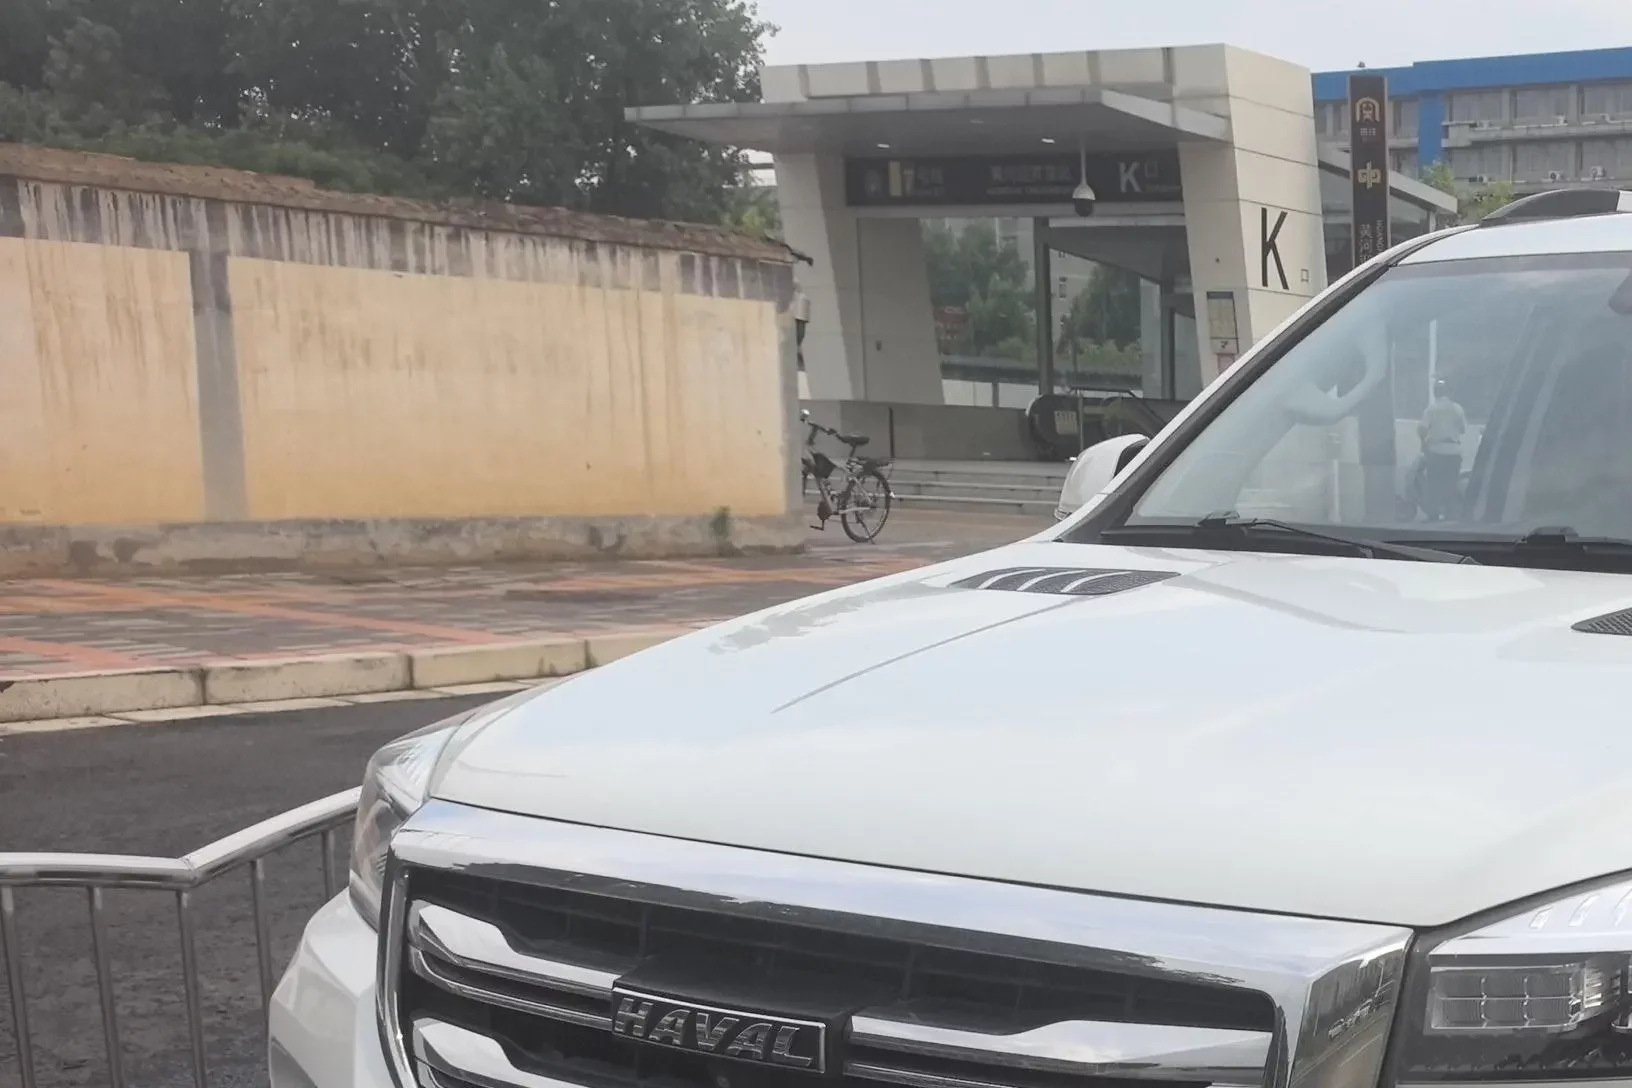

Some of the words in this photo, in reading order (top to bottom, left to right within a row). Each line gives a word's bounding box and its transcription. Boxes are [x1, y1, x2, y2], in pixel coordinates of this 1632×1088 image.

[1118, 161, 1142, 193] K
[1261, 206, 1290, 290] K
[616, 996, 814, 1068] HAVAL
